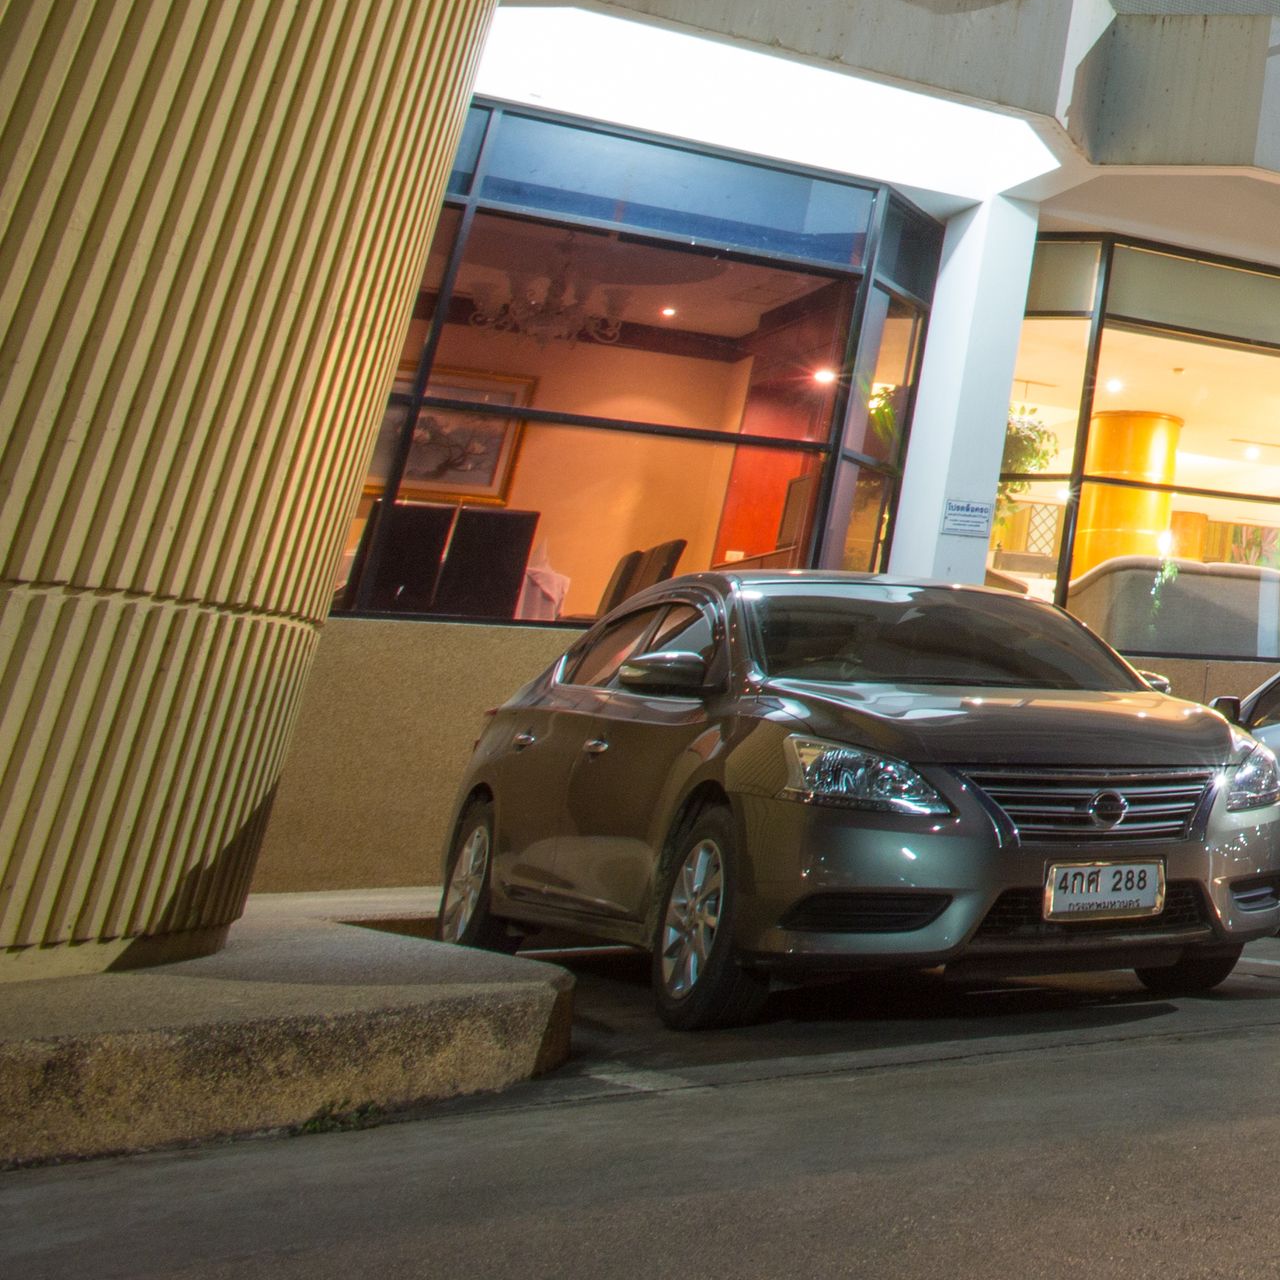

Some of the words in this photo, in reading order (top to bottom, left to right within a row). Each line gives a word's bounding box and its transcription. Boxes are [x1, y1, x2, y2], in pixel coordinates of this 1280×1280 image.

[1111, 869, 1148, 892] 288
[1068, 898, 1141, 911] กรงเทพมหานคร
